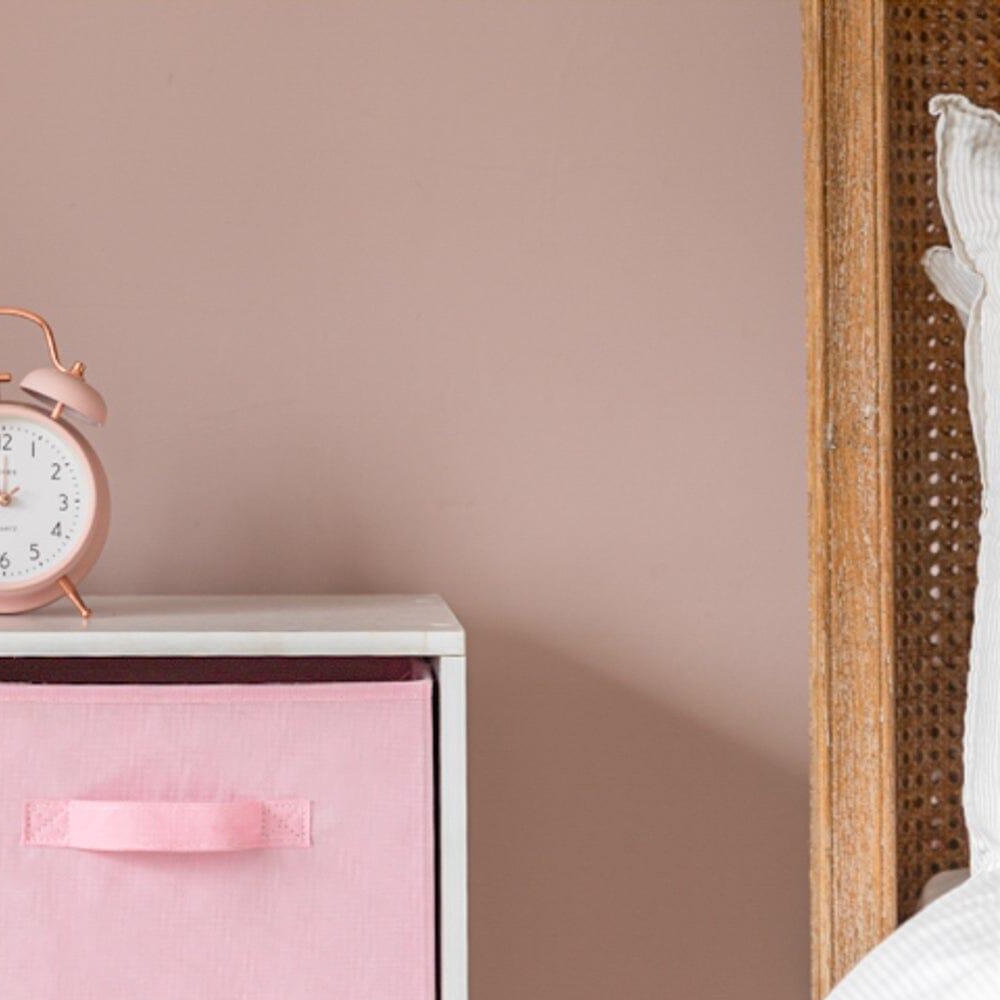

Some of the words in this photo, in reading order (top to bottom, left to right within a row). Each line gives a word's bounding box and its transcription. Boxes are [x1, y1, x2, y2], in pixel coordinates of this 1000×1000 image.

[50, 462, 62, 480] 2
[59, 494, 69, 511] 3
[50, 522, 62, 538] 4
[29, 544, 40, 561] 5
